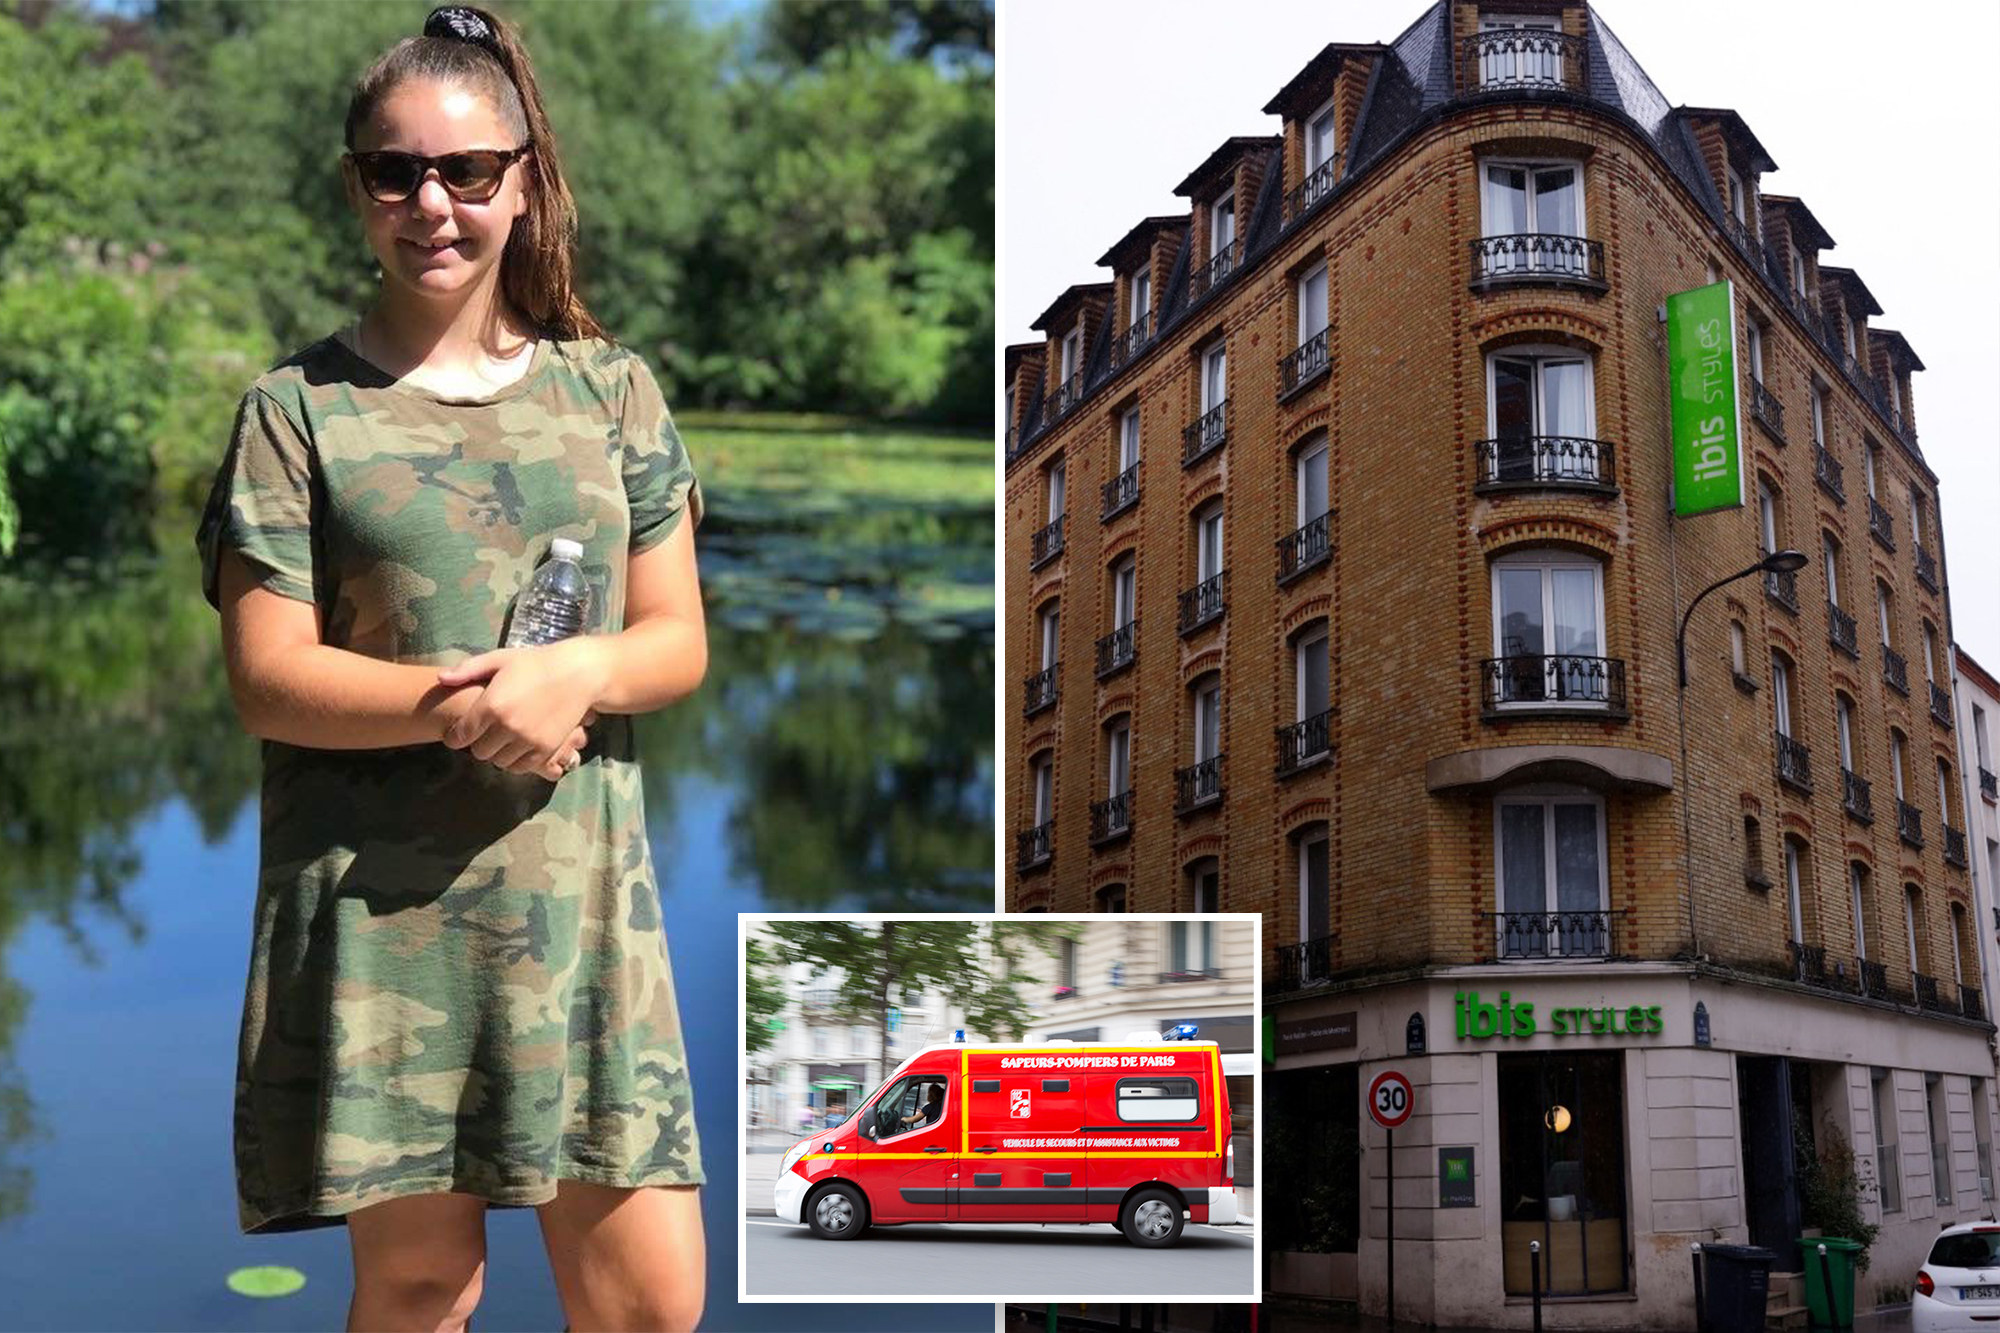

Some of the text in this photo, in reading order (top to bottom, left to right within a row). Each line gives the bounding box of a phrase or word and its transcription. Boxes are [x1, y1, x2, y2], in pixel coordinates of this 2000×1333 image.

[1693, 415, 1727, 482] ibis
[1455, 991, 1536, 1037] ibis
[1001, 1055, 1176, 1068] SAPEURS-POMPIERS DE PARIS
[1378, 1086, 1406, 1112] 30
[1036, 1138, 1046, 1148] DE
[1046, 1138, 1077, 1148] SECOURS
[1077, 1138, 1086, 1147] ET
[1134, 1138, 1148, 1147] AUX
[1147, 1138, 1180, 1147] VICTIMES
